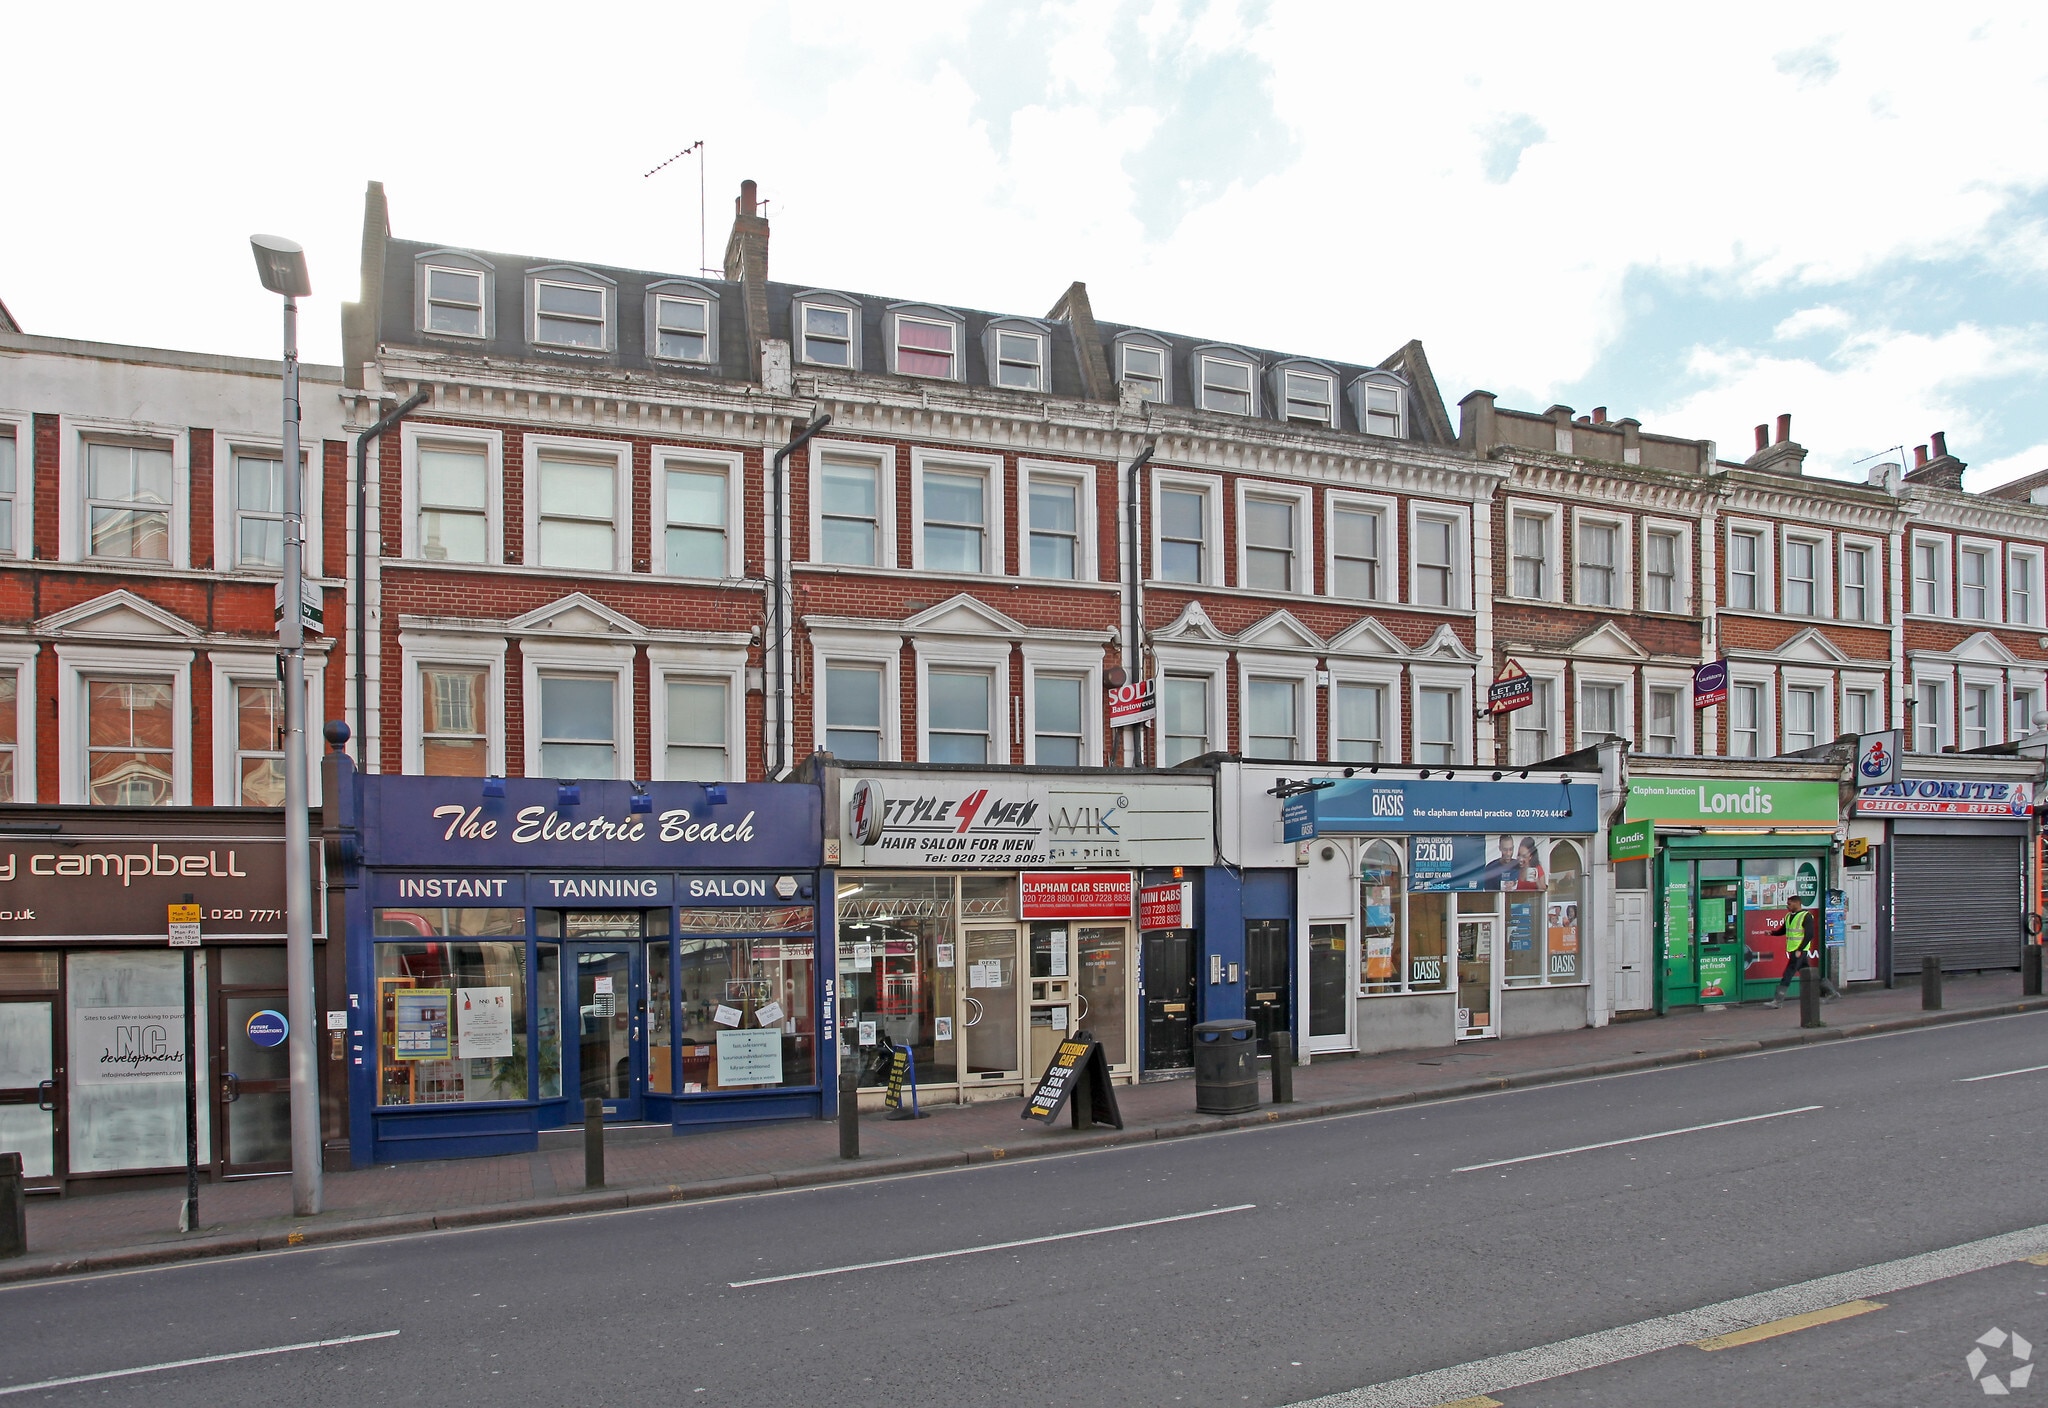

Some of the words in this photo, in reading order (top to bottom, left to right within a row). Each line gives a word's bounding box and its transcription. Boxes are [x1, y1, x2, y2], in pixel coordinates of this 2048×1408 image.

[303, 605, 312, 616] by
[1108, 680, 1155, 706] SOLD
[1491, 686, 1511, 697] LET
[1514, 681, 1529, 691] BY
[1372, 795, 1404, 816] OASIS
[1632, 786, 1665, 796] Clapham
[1666, 786, 1696, 795] Junction
[1698, 786, 1773, 814] Londis
[884, 796, 957, 825] STYLE
[955, 789, 989, 834] 4
[983, 797, 1040, 827] MEN
[1863, 801, 1940, 812] CHICKEN
[1945, 803, 1957, 812] &
[1967, 803, 2007, 813] RIBS
[1412, 808, 1426, 817] the
[1427, 808, 1458, 819] clapham
[1459, 808, 1483, 817] dental
[1484, 808, 1513, 819] practice
[1516, 809, 1530, 817] 020
[1531, 809, 1549, 817] 7924
[432, 805, 498, 841] The
[510, 805, 647, 844] Electric
[657, 809, 756, 843] Beach
[1301, 824, 1313, 836] OASIS
[880, 837, 917, 849] HAIR
[920, 837, 969, 850] SALON
[970, 838, 1001, 850] FOR
[1002, 839, 1035, 851] MEN
[1615, 832, 1644, 844] Londis
[924, 853, 948, 863] Tel:
[950, 853, 977, 863] 020
[979, 853, 1011, 863] 7223
[1014, 853, 1046, 863] 8085
[1083, 847, 1120, 859] print
[1415, 844, 1453, 861] £26.00
[30, 843, 247, 888] campbell
[399, 878, 508, 898] INSTANT
[548, 878, 658, 898] TANNING
[689, 879, 767, 898] SALON
[1022, 882, 1069, 893] CLAPHAM
[1071, 882, 1090, 892] CAR
[1092, 882, 1131, 892] SERVICE
[1430, 881, 1451, 889] basics
[1022, 894, 1036, 902] 020
[1037, 894, 1056, 902] 7228
[1057, 894, 1075, 902] 8800
[1080, 894, 1094, 902] 020
[1095, 894, 1113, 902] 7228
[1113, 894, 1131, 902] 8836
[1141, 892, 1158, 904] MINI
[1160, 889, 1181, 902] CABS
[211, 908, 244, 920] 020
[1141, 905, 1151, 915] 020
[1152, 904, 1166, 914] 7228
[1166, 903, 1181, 913] 8800
[1141, 917, 1151, 926] 020
[1152, 915, 1166, 925] 7228
[1166, 914, 1181, 924] 8836
[1765, 918, 1779, 928] Top
[1413, 960, 1440, 979] OASIS
[1551, 955, 1575, 973] OASIS
[138, 1013, 161, 1021] looking
[1058, 1042, 1089, 1057] INTERNET
[100, 1047, 185, 1069] developments
[1058, 1054, 1077, 1067] CAFE
[1049, 1066, 1073, 1078] COPY
[1047, 1077, 1064, 1087] FAX
[1038, 1086, 1062, 1098] SCAN
[1032, 1095, 1058, 1108] PRINT
